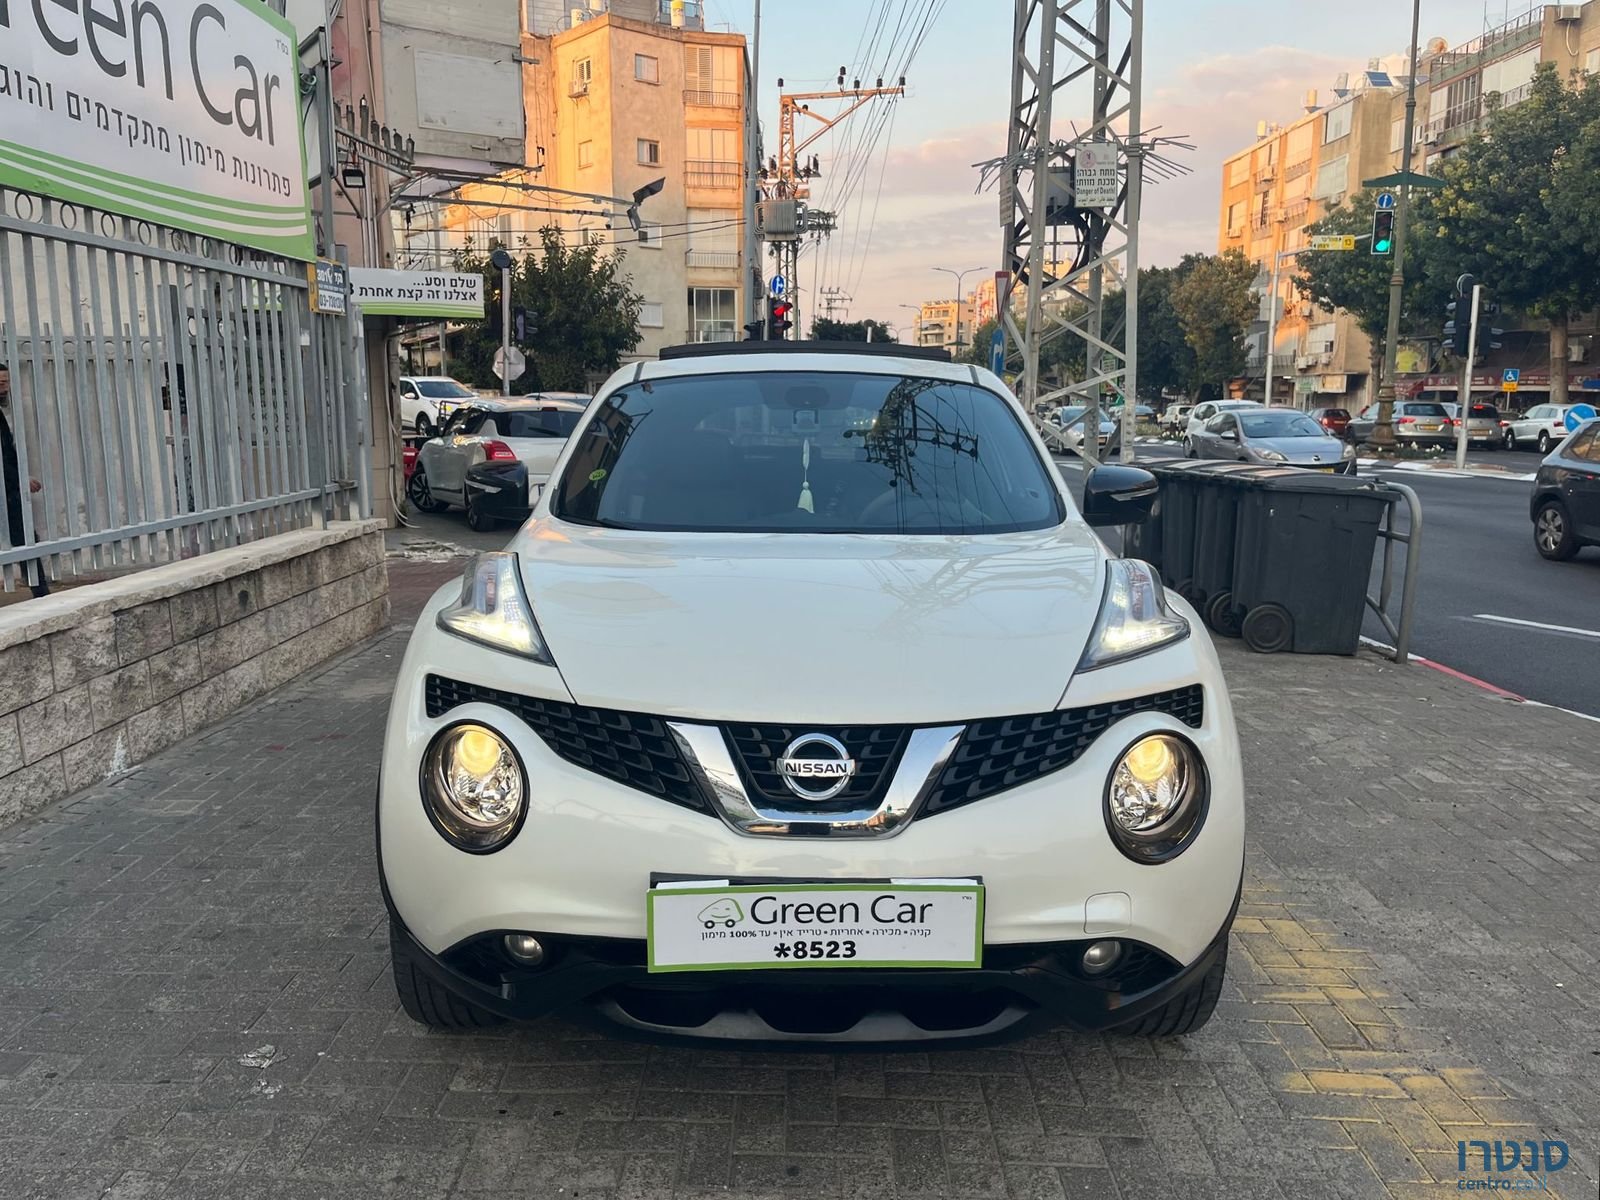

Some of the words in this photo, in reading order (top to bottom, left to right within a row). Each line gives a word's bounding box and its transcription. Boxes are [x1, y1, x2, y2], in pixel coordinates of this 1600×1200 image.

[0, 0, 173, 100] een
[190, 3, 280, 146] Car
[66, 90, 171, 153] מתקדמים
[178, 134, 226, 173] מימון
[232, 156, 291, 197] פתרונות
[1077, 187, 1093, 196] Danger
[413, 276, 446, 287] וסע...
[450, 277, 476, 289] שלם
[359, 286, 393, 297] אחרת
[397, 288, 423, 301] קצת
[427, 289, 441, 299] זה
[444, 288, 477, 301] אצלנו
[785, 763, 847, 774] NISSAN
[750, 896, 860, 925] Green
[870, 895, 933, 924] Car
[701, 931, 726, 941] מימון
[779, 929, 794, 939] אין
[797, 929, 821, 937] טרייד
[830, 928, 864, 936] אחריות
[872, 928, 901, 936] מכירה
[910, 928, 931, 938] קניה
